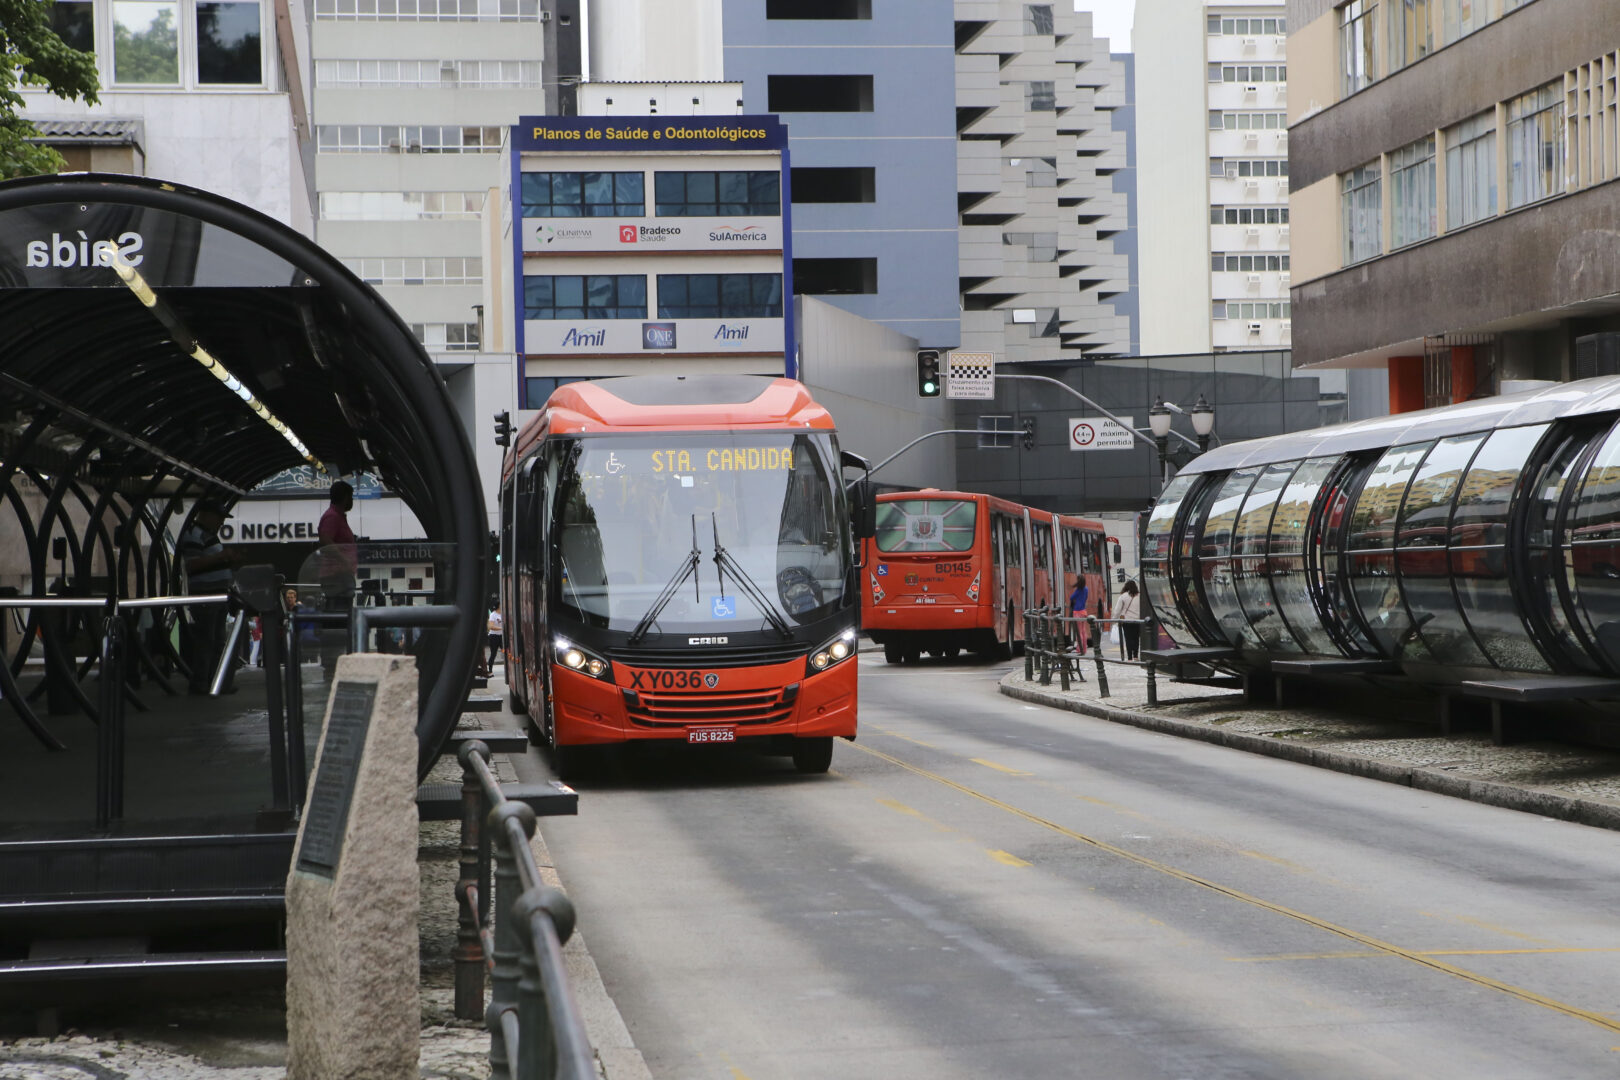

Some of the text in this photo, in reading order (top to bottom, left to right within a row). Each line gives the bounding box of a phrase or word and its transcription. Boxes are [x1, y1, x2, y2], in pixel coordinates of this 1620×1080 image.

[533, 126, 767, 142] Planos de Saúde e Odontológicos
[640, 226, 681, 235] Bradesco
[562, 327, 606, 347] Amil
[647, 328, 673, 342] ONE
[714, 324, 749, 340] Amil
[1096, 438, 1132, 447] permitida
[652, 447, 795, 473] STA. CANDIDA
[240, 521, 319, 540] NICKEL
[935, 562, 972, 574] BD145
[688, 636, 729, 646] CAIO
[630, 670, 702, 689] XY036
